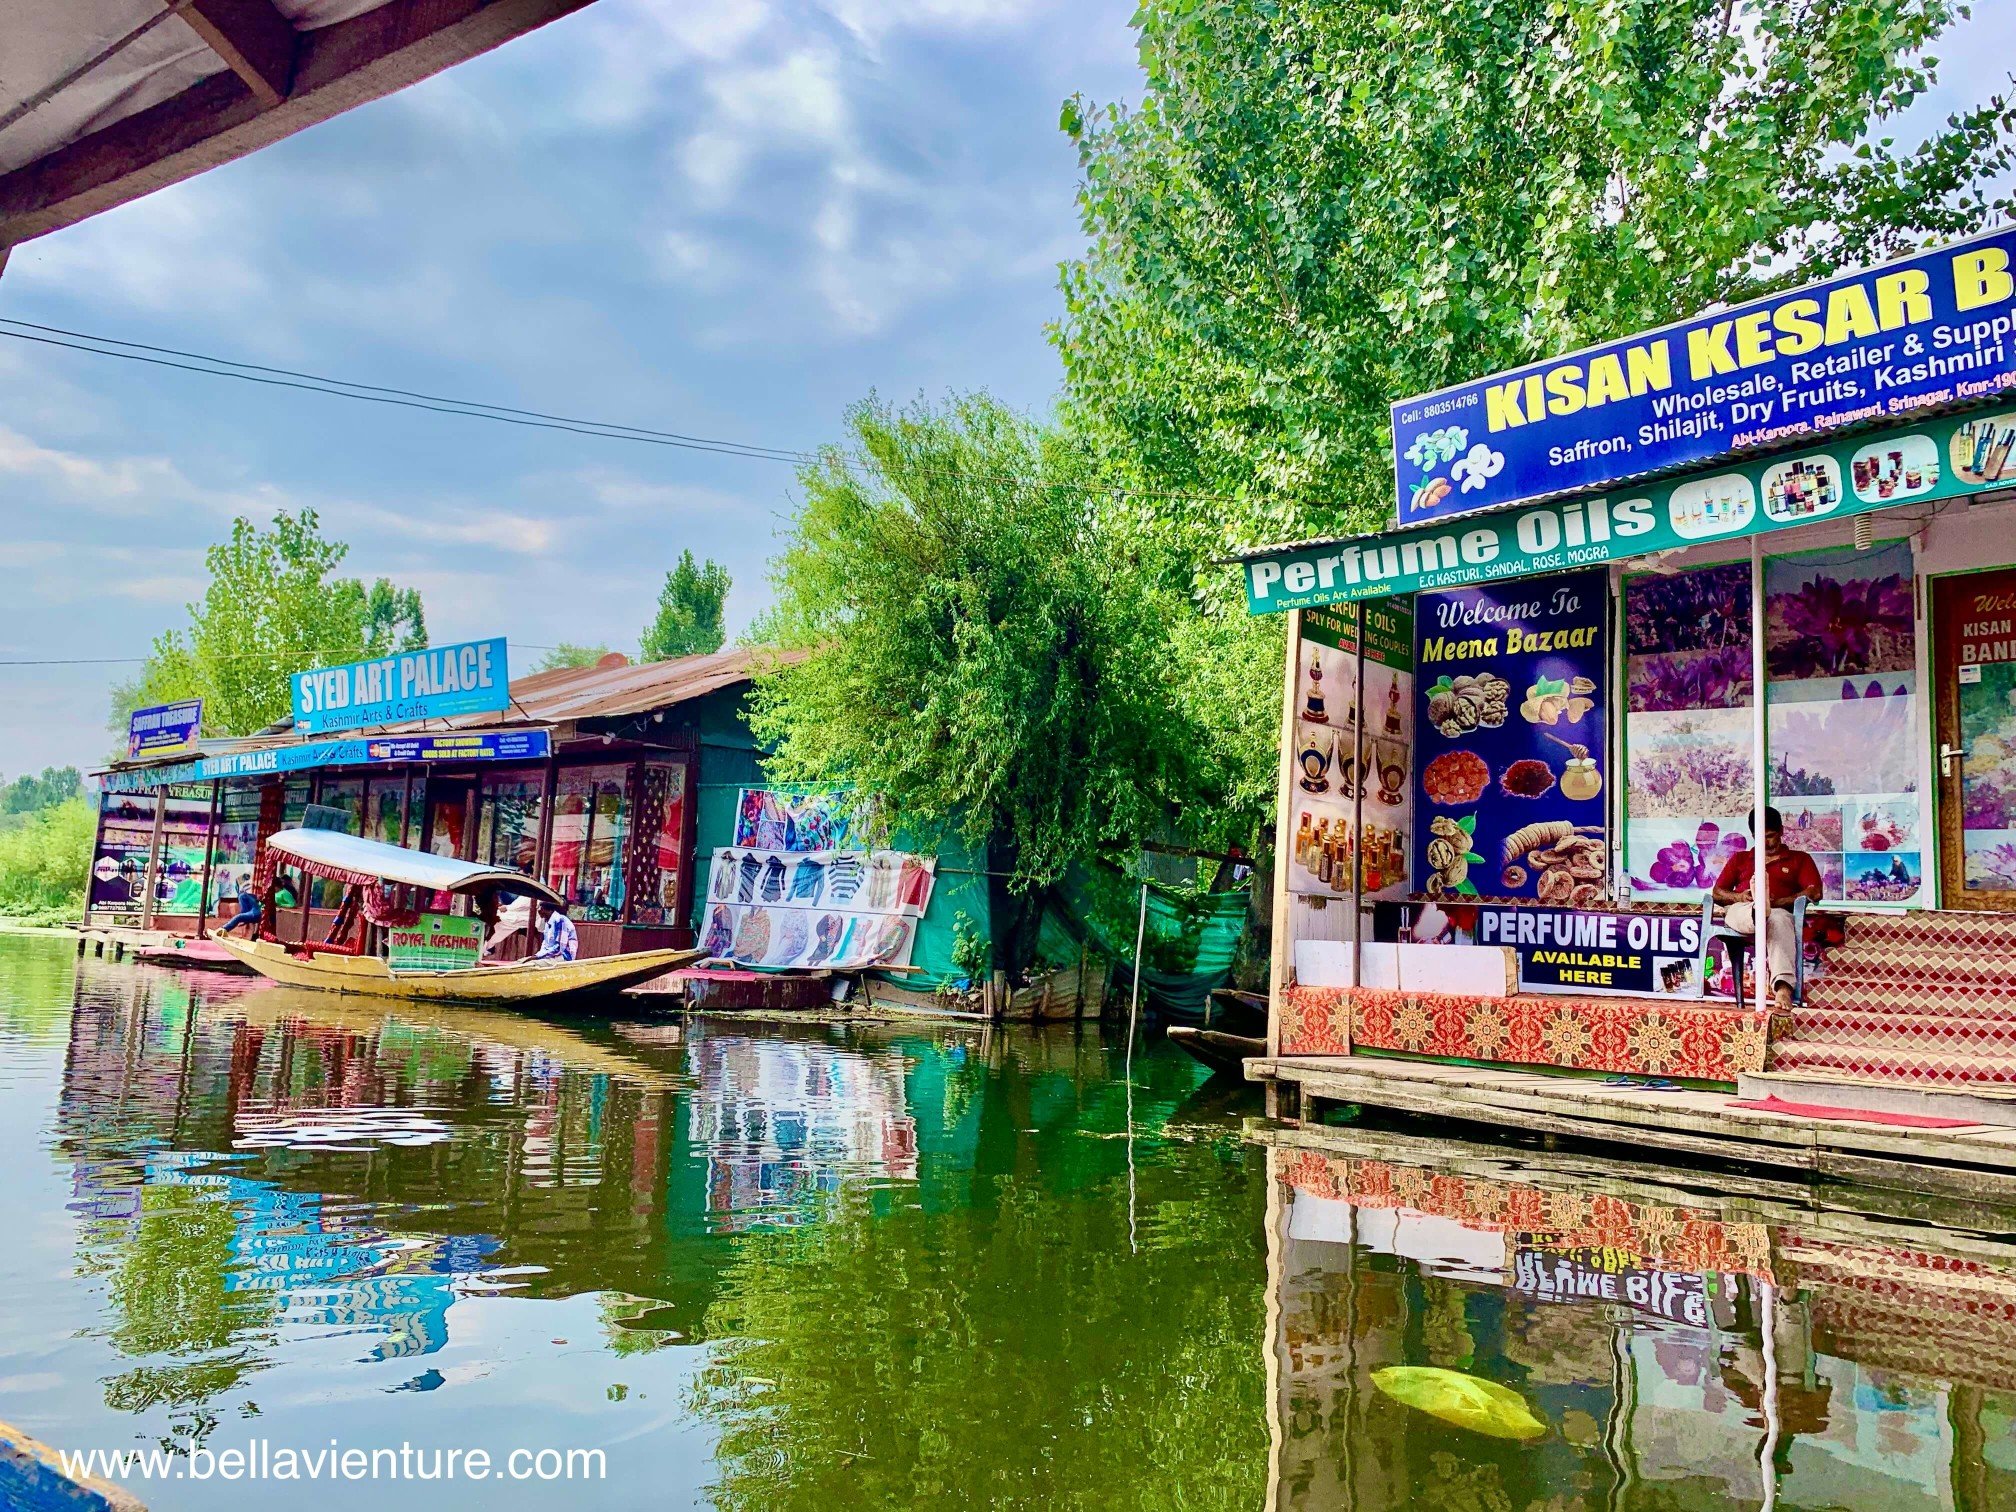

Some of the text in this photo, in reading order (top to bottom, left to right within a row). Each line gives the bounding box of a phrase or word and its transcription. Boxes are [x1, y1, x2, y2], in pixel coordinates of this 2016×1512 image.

[1485, 340, 1672, 434] KISAN
[1688, 269, 1933, 381] KESAR
[1651, 373, 1784, 418] Wholesale,
[1791, 343, 1895, 385] Retailer
[1902, 333, 1925, 358] &
[1401, 393, 1479, 425] Cell: 8803514766
[1548, 339, 2004, 467] Saffron, Shilajit, Dry Fruits, Kashmiri
[1250, 497, 1656, 599] Perfume Oils
[1567, 545, 1610, 564] MOGRA
[1276, 584, 1392, 609] Perfume Oils Are Available
[1436, 598, 1542, 629] Welcome
[1548, 588, 1582, 616] To
[1326, 617, 1341, 633] FOR
[1380, 635, 1410, 656] COUPLES
[1374, 612, 1397, 634] OILS
[1963, 620, 2012, 637] KISAN
[1422, 625, 1598, 663] Meena Bazaar
[301, 643, 494, 714] SYED ART PALACE
[321, 712, 361, 729] Kashmir
[362, 709, 383, 725] Arts
[385, 706, 393, 720] &
[396, 702, 428, 719] Crafts
[433, 739, 455, 747] FACTORY
[202, 752, 277, 777] SYED ART PALACE
[1482, 911, 1700, 953] PERFUME OILS
[1531, 950, 1642, 970] AVAILABLE
[1559, 969, 1613, 985] HERE
